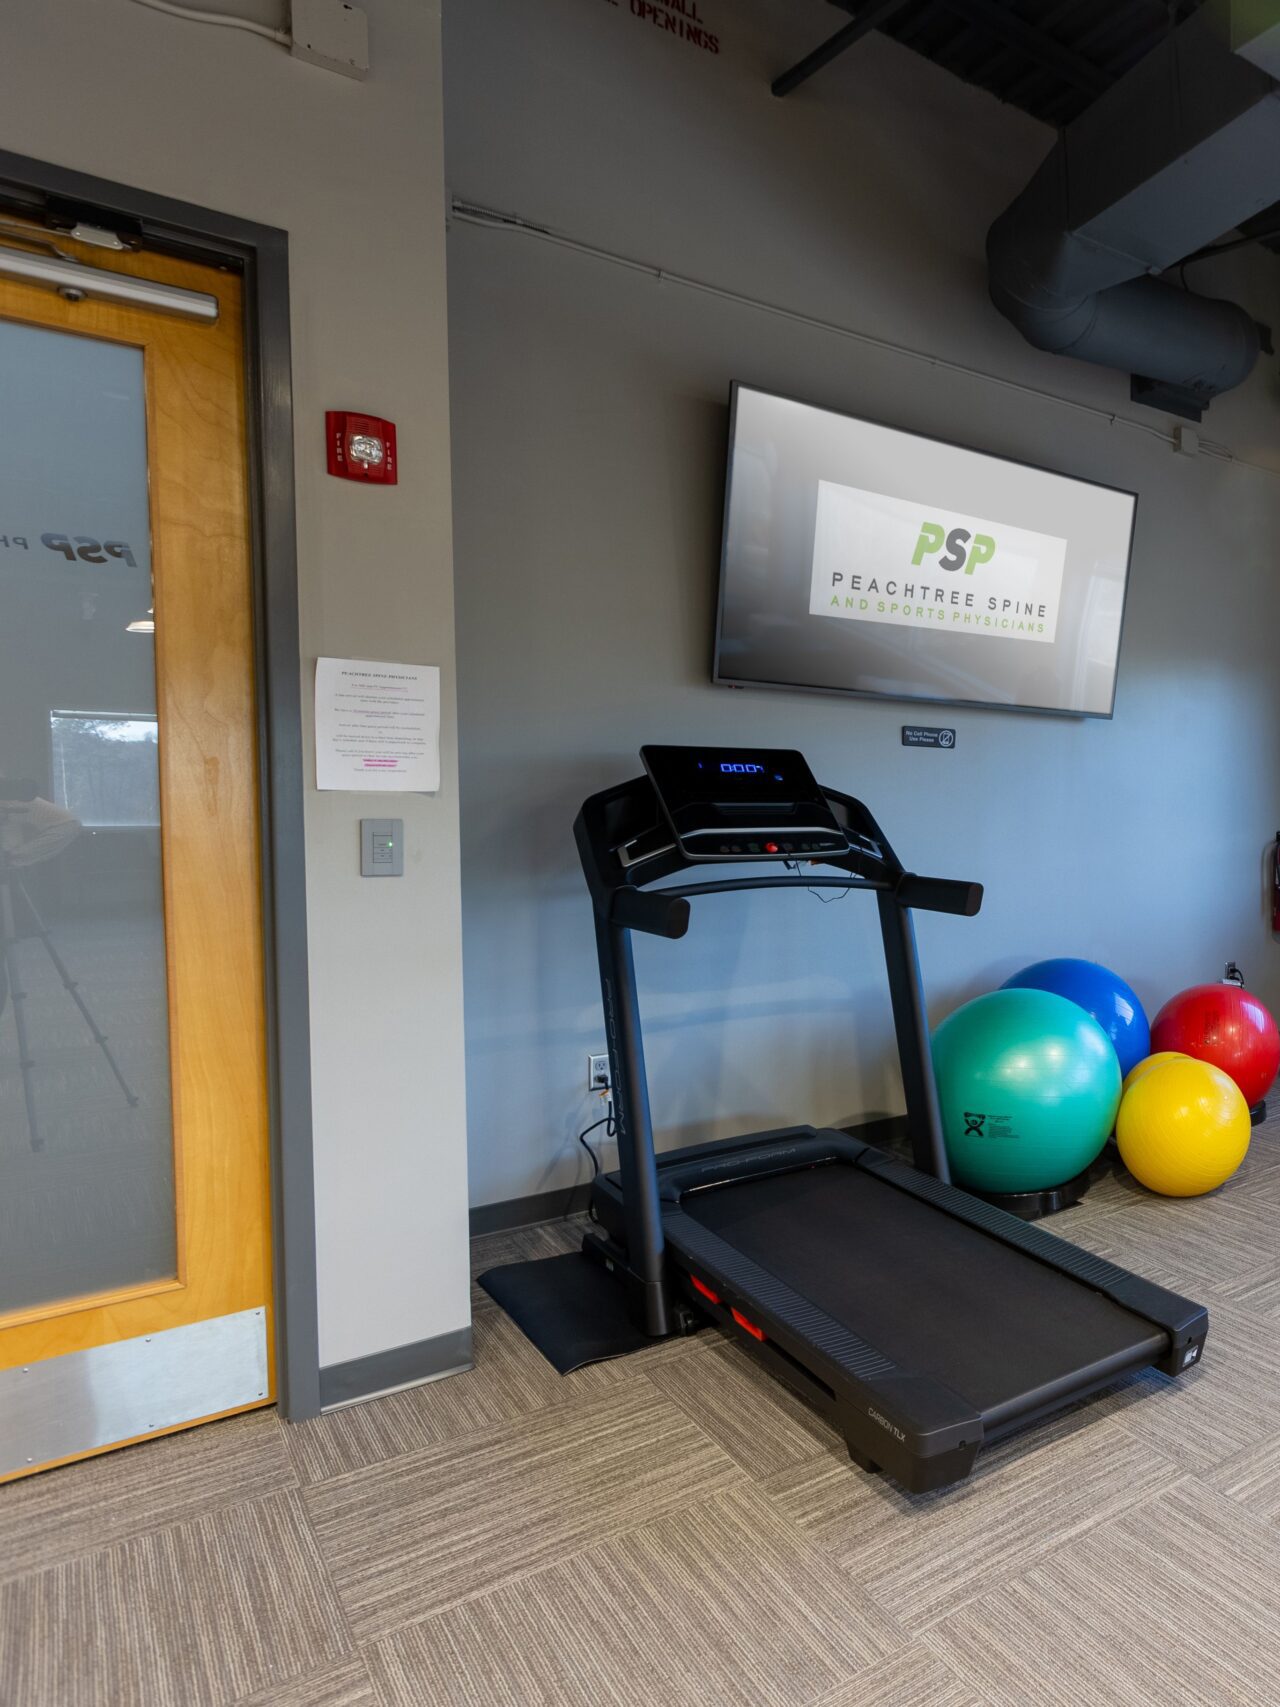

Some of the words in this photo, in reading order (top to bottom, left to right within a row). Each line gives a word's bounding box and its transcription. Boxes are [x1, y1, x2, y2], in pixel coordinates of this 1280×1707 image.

[630, 0, 720, 54] OPENINGS
[911, 521, 996, 575] PSP
[830, 595, 869, 611] AND
[876, 601, 946, 621] SPORTS
[952, 612, 1045, 633] PHYSICIANS
[831, 571, 975, 608] PEACHTREE
[987, 597, 1047, 618] SPINE
